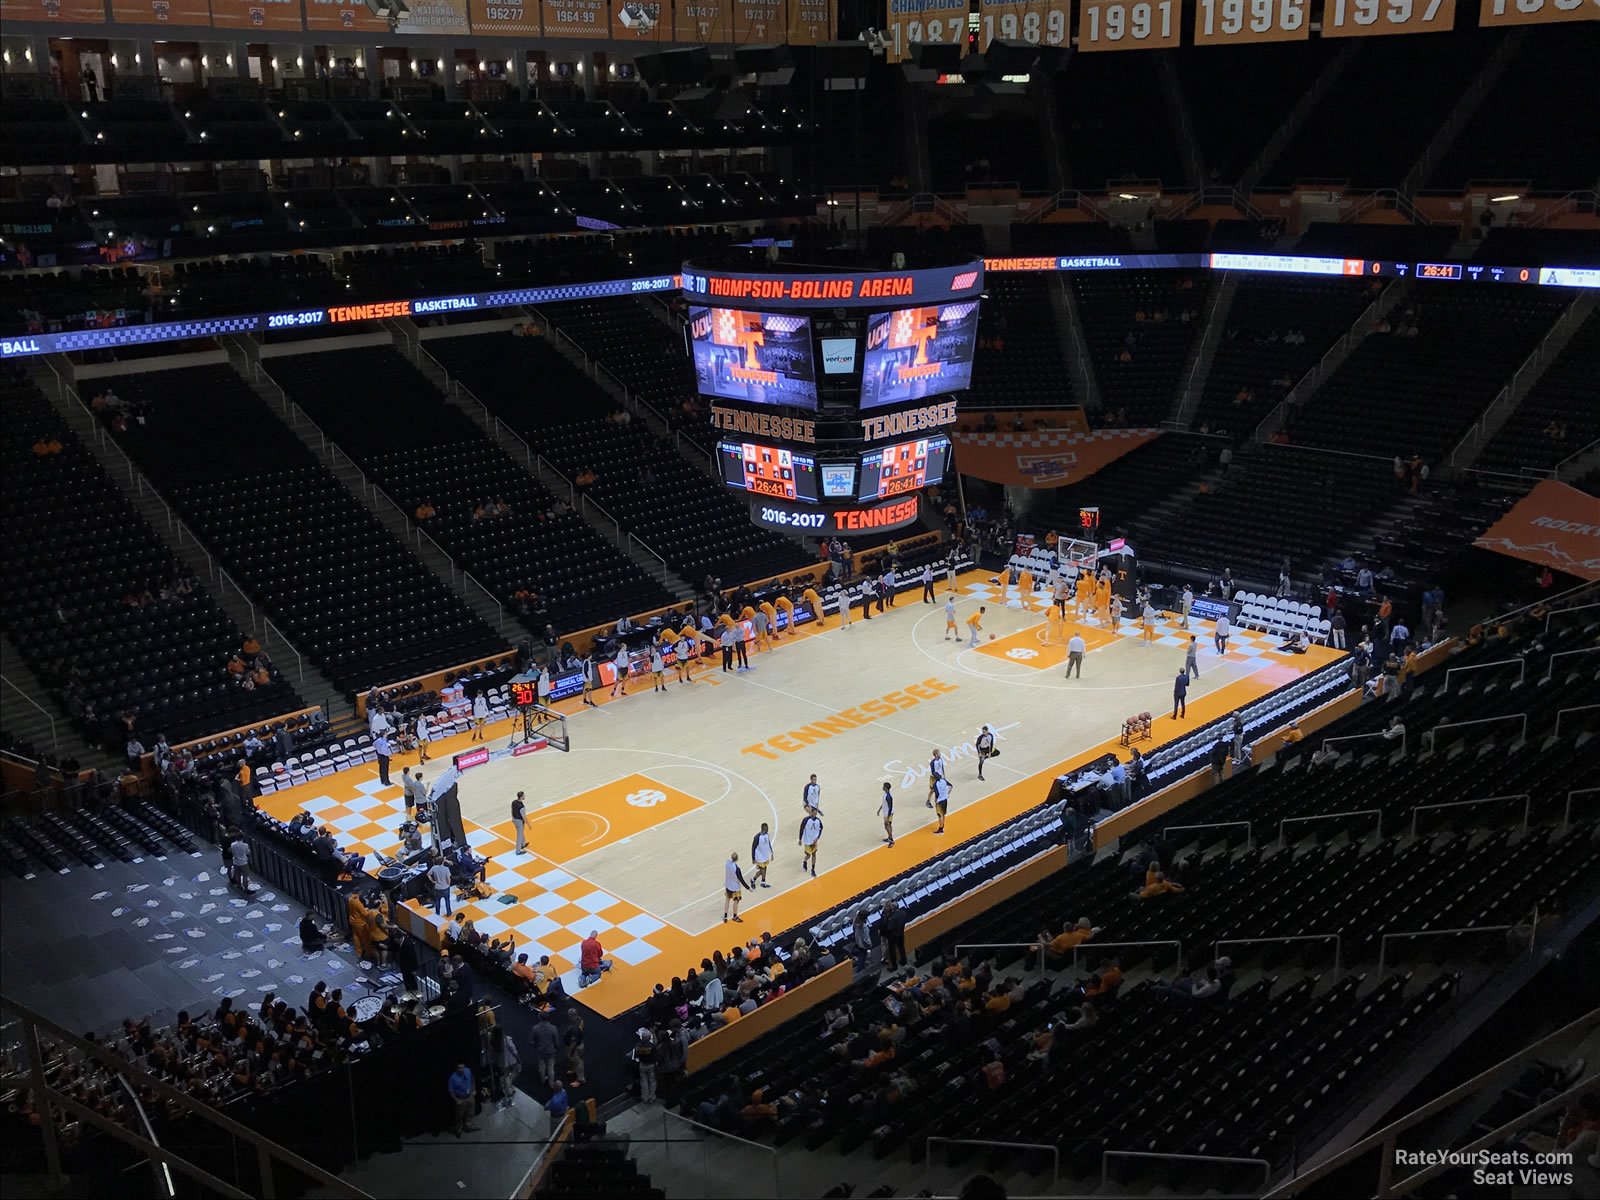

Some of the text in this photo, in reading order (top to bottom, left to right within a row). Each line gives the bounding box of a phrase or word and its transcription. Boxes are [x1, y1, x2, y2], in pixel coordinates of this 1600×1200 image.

[1088, 1, 1171, 41] 1991
[1202, 0, 1303, 35] 1996
[983, 257, 1121, 270] TENNESSEE BASKETBALL
[1347, 261, 1359, 274] T
[1372, 262, 1380, 274] 0
[1424, 265, 1453, 276] 26:41
[1520, 269, 1529, 281] 0
[1546, 271, 1558, 283] A
[631, 280, 670, 291] 2016-2017
[695, 276, 707, 294] TO
[709, 277, 853, 299] THOMPSON-BOLING
[859, 277, 913, 297] ARENA
[269, 297, 478, 328] 2016-2017 TENNESSEE BASKETBALL
[731, 367, 778, 383] TENNESSEE
[711, 406, 816, 444] TENNESSEE
[862, 401, 957, 442] TENNESSEE
[918, 443, 924, 454] A
[781, 453, 789, 464] A
[784, 470, 789, 478] 0
[885, 468, 889, 476] 0
[757, 481, 784, 495] 26:41
[890, 478, 914, 493] 26:41
[761, 507, 826, 528] 2016-2017
[1081, 516, 1092, 527] 30
[1119, 570, 1127, 580] T
[512, 682, 535, 692] 26:41
[517, 691, 533, 704] 30
[740, 677, 960, 760] TENNESSEE
[459, 753, 487, 767] NISSAN
